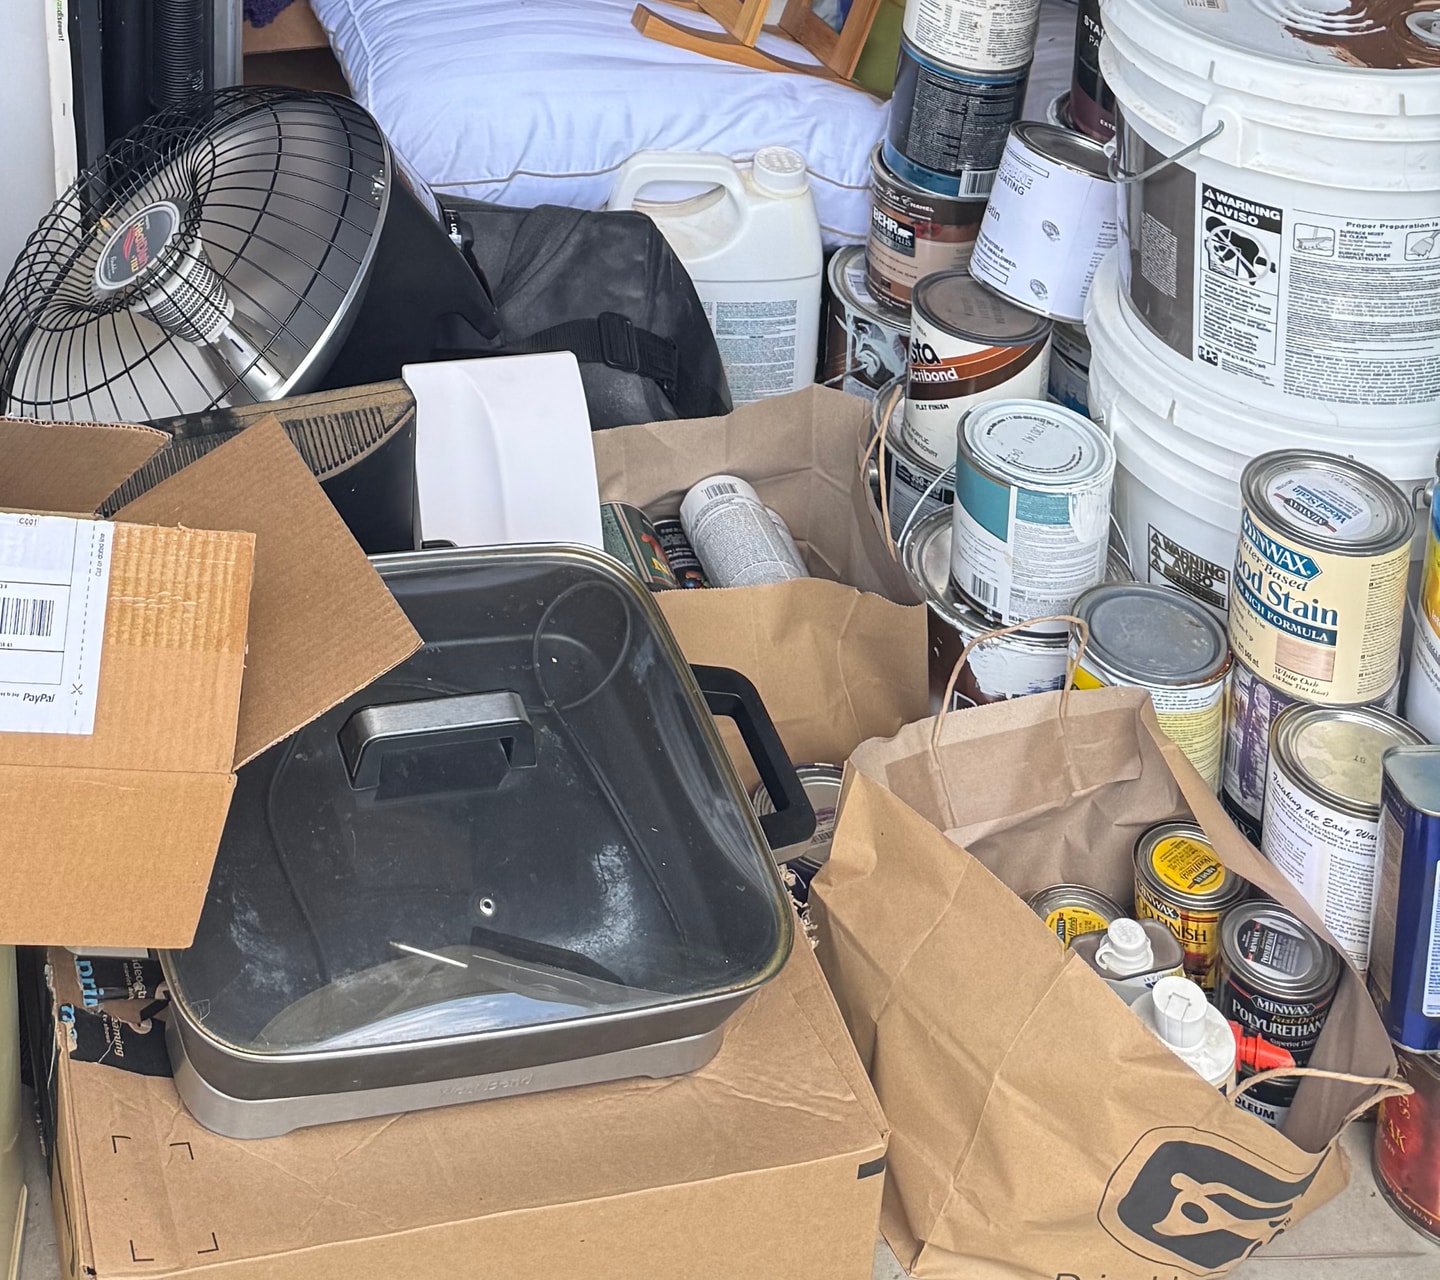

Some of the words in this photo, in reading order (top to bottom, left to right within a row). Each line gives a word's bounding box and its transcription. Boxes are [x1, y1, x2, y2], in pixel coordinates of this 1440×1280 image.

[1084, 15, 1106, 37] STAI
[1099, 119, 1116, 132] EXTE
[873, 206, 898, 234] BEHR
[1215, 191, 1281, 221] WARNING
[1215, 204, 1259, 226] AVISO
[1346, 221, 1377, 230] Proper
[1379, 222, 1430, 230] Preparation
[910, 337, 942, 365] sta
[1162, 536, 1226, 581] WARNING
[1172, 558, 1214, 588] AVISO
[1237, 553, 1263, 596] ood
[1266, 580, 1338, 627] Stain
[1267, 609, 1329, 642] FORMULA
[22, 692, 56, 704] PayPal
[1272, 771, 1302, 811] Finishing
[1304, 809, 1320, 821] the
[1322, 817, 1351, 837] Easy
[1156, 913, 1207, 941] FINISH
[1232, 999, 1322, 1037] POLYURETHAN
[1256, 998, 1312, 1016] MINWAX
[1271, 1014, 1325, 1025] Fast-Dry
